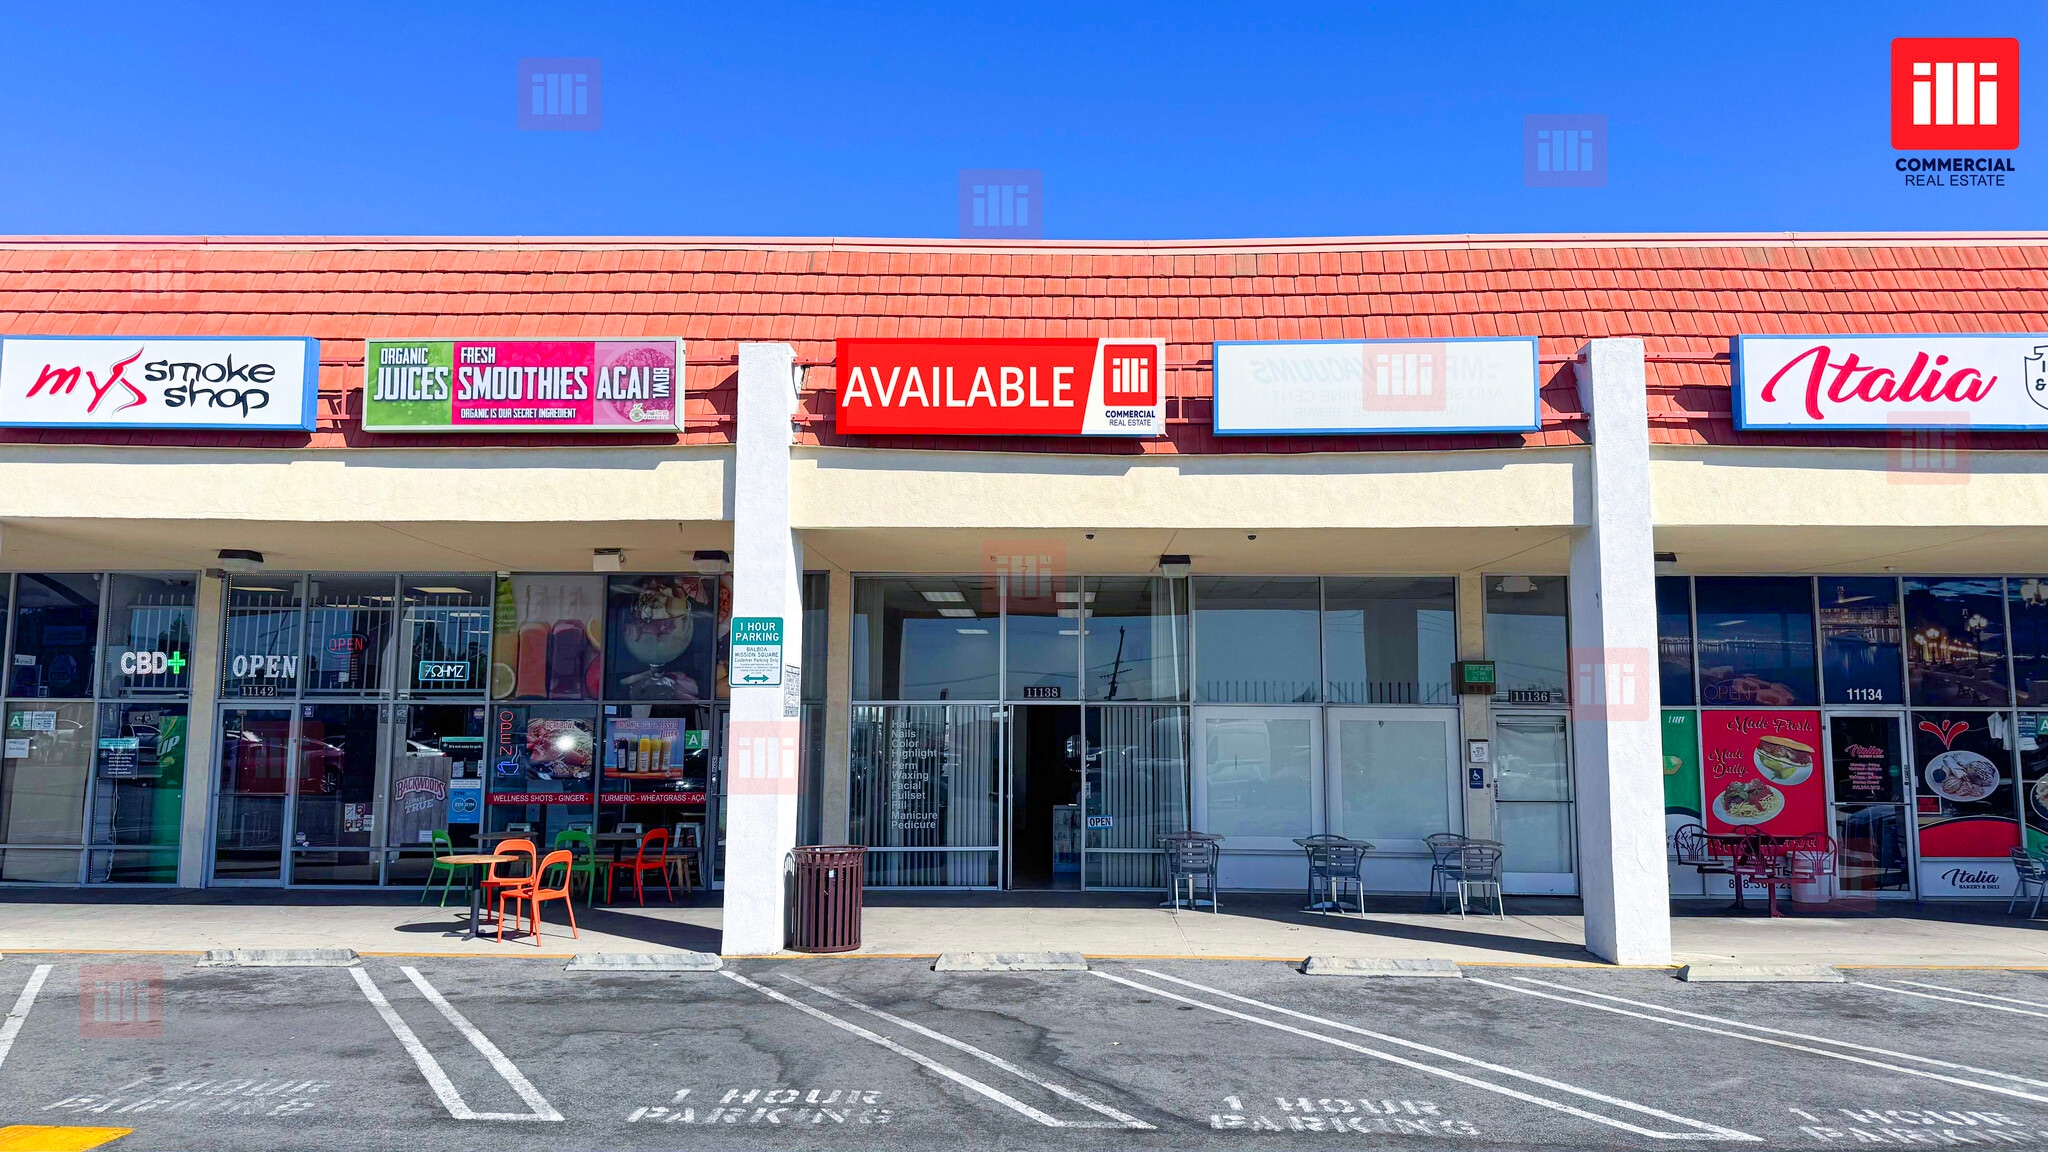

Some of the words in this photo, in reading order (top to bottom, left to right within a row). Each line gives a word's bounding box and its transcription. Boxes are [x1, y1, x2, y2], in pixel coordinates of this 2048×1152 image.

[380, 347, 429, 365] ORGANIC
[460, 346, 496, 364] FRESH
[145, 353, 275, 383] smoke
[1112, 358, 1148, 393] illi
[373, 366, 449, 401] JUICES
[457, 366, 589, 400] SMOOTHIES
[596, 366, 650, 400] ACAI
[652, 367, 670, 399] BOWL
[841, 366, 1074, 407] AVAILABLE
[1761, 345, 1998, 420] Italia
[164, 378, 269, 418] shop
[460, 408, 489, 419] ORGANIC
[490, 408, 497, 419] IS
[498, 408, 512, 419] OUR
[513, 408, 537, 419] SECRET
[538, 408, 577, 419] INGREDIENT
[1105, 410, 1156, 418] COMMERCIAL
[1109, 419, 1127, 427] REAL
[1127, 419, 1151, 427] ESTATE
[740, 622, 744, 631] 1
[748, 622, 776, 631] HOUR
[735, 632, 780, 642] PARKING
[329, 637, 364, 651] OPEN
[232, 655, 298, 679] OPEN
[241, 686, 275, 697] 11142
[1026, 687, 1059, 698] 11138
[1514, 691, 1548, 702] 11136
[1846, 688, 1882, 701] 11134
[891, 719, 913, 729] Hair
[1727, 715, 1769, 735] Made
[500, 711, 514, 756] OPEN
[688, 734, 699, 746] A
[891, 729, 916, 739] Nails
[891, 739, 919, 748] Color
[891, 749, 937, 760] Highlight
[1708, 748, 1745, 764] Made
[891, 760, 918, 770] Perm
[891, 771, 929, 782] Waxing
[395, 776, 447, 801] BACKWOODS
[891, 780, 922, 790] Facial
[493, 794, 529, 802] WELLNESS
[530, 794, 553, 802] SHOTS
[558, 794, 585, 802] GINGER
[601, 794, 636, 802] TURMERIC
[641, 794, 686, 802] WHEATGRASS
[891, 790, 926, 800] Fullset
[405, 798, 434, 814] TRUE
[891, 800, 907, 810] Fill
[891, 810, 938, 820] Manicure
[1089, 817, 1111, 826] OPEN
[891, 820, 936, 829] Pedicure
[1941, 868, 2000, 887] Italia
[672, 1088, 691, 1104] 1
[719, 1088, 883, 1105] HOUR
[1223, 1095, 1244, 1111] 1
[1274, 1097, 1441, 1115] HOUR
[1837, 1108, 2026, 1127] HOUR
[1210, 1114, 1481, 1136] PARKING
